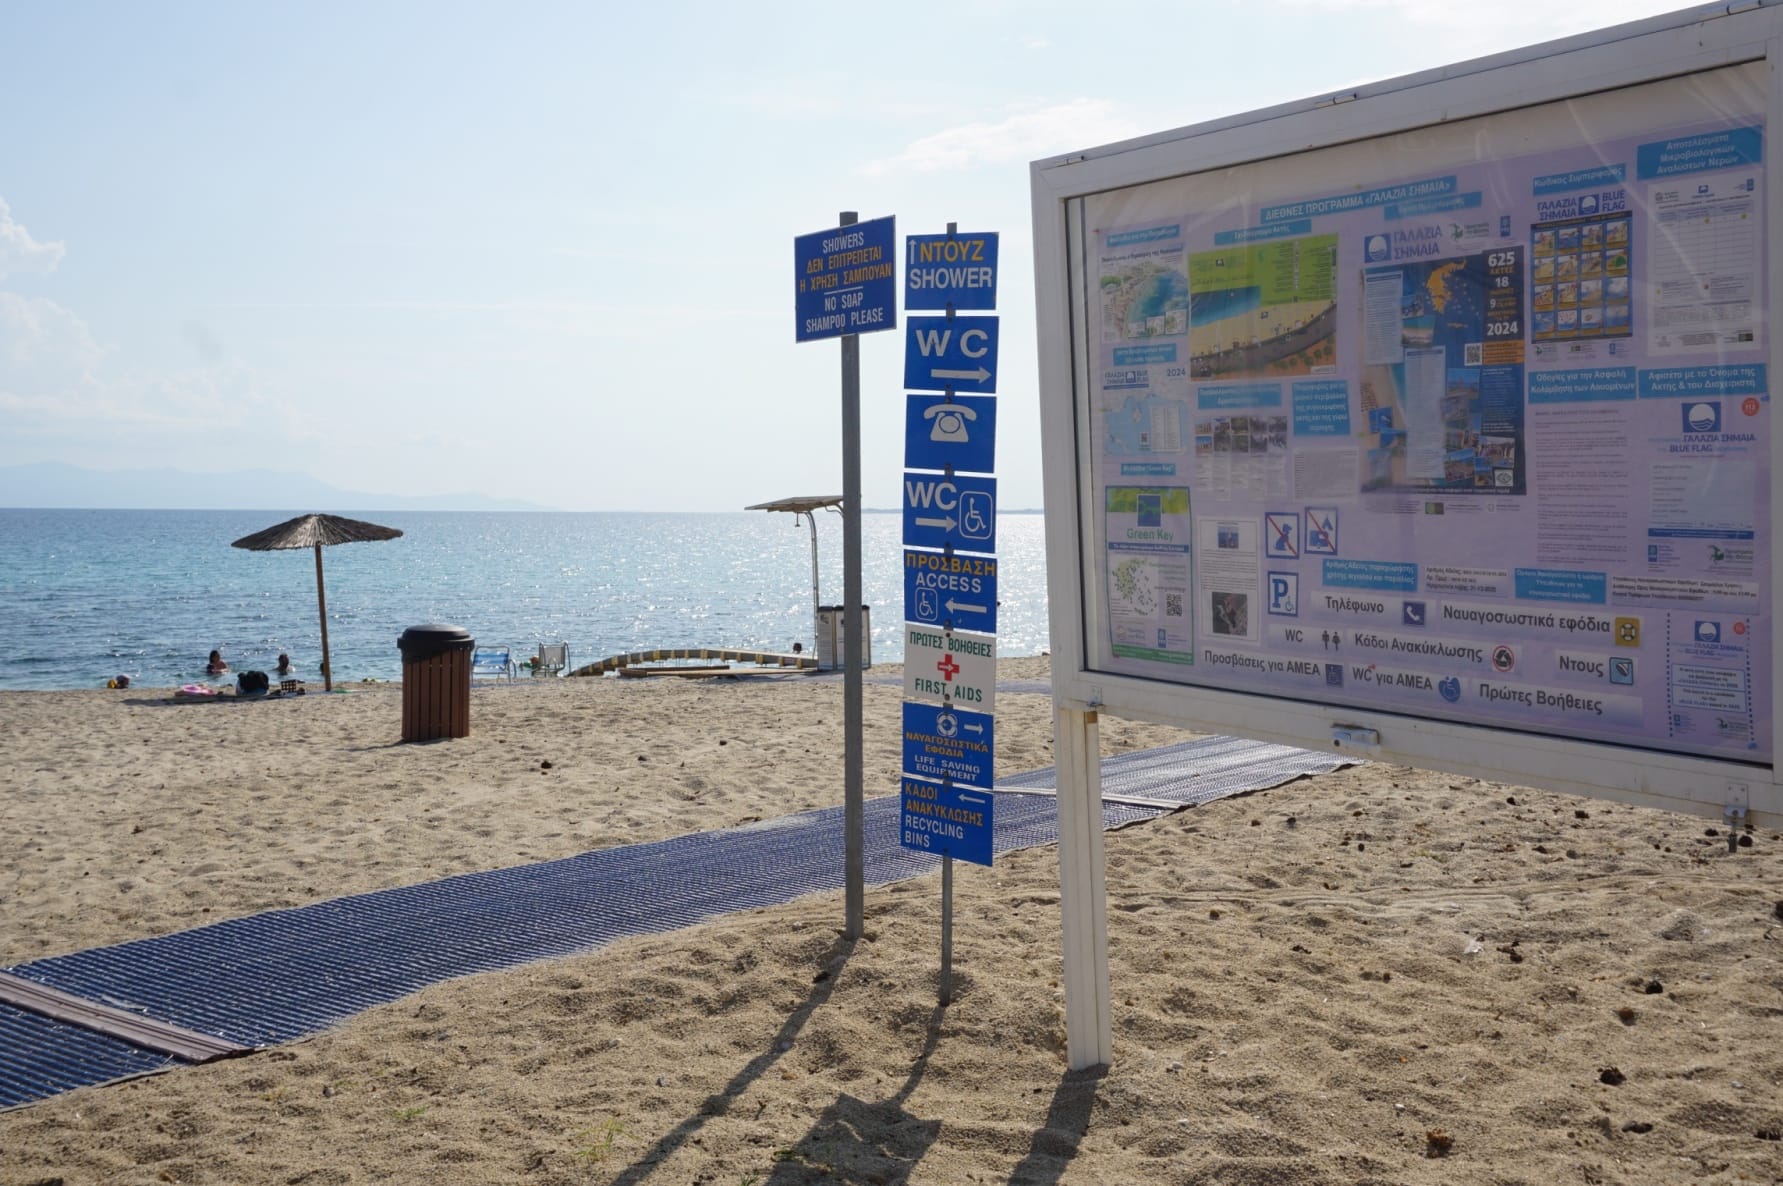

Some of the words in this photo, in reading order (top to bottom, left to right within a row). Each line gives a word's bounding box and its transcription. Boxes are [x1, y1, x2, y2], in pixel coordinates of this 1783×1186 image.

[1537, 197, 1577, 211] ΓΑΛΑΖΙΑ
[1602, 189, 1626, 202] BLUE
[1602, 200, 1626, 212] FLAG
[1265, 205, 1304, 220] ΔΙΕΘΝΕΣ
[1306, 197, 1364, 214] ΠΡΟΓΡΑΜΜΑ
[1539, 208, 1577, 221] ΣΗΜΑΙΑ
[822, 232, 864, 254] SHOWERS
[1393, 224, 1442, 244] ΓΑΛΑΖΙΑ
[806, 259, 824, 274] ΔΕΝ
[829, 246, 882, 270] ΕΠΙΤΡΕΠΕΤΑΙ
[920, 240, 984, 263] ΝΤΟΥΖ
[1394, 242, 1440, 259] ΣΗΜΑΙΑ
[1488, 252, 1515, 268] 625
[800, 278, 806, 293] Η
[811, 273, 838, 291] ΧΡΗΣΗ
[843, 262, 892, 285] ΣΑΜΠΟΥΑΝ
[910, 267, 992, 290] SHOWER
[1496, 276, 1509, 288] 18
[824, 295, 837, 311] NO
[841, 292, 864, 309] SOAP
[1490, 299, 1496, 309] 9
[806, 314, 846, 333] SHAMPOO
[851, 307, 884, 326] PLEASE
[1487, 322, 1518, 336] 2024
[906, 481, 957, 510] WC
[1127, 528, 1157, 540] Green
[1158, 530, 1174, 542] Key
[906, 553, 995, 576] ΠΡΟΣΒΑΣΗ
[916, 572, 982, 593] ACCESS
[1272, 578, 1288, 608] P
[1325, 596, 1385, 614] Τηλέφωνο
[1444, 606, 1554, 628] Ναυαγοσωστικά
[1560, 616, 1610, 633] εφόδια
[910, 632, 944, 649] ΠΡΩΤΕΣ
[948, 638, 992, 658] ΒΟΗΘΕΙΕΣ
[1285, 629, 1304, 642] WC
[1354, 634, 1388, 650] Κάδοι
[1392, 637, 1483, 662] Ανακύκλωσης
[1204, 650, 1265, 672] Προσβάσεις
[1268, 660, 1284, 672] για
[1286, 660, 1320, 676] ΑΜΕΑ
[1560, 656, 1604, 677] Ντους
[1352, 667, 1372, 682] WC
[1376, 672, 1393, 686] για
[1396, 673, 1433, 690] ΑΜΕΑ
[915, 678, 947, 696] FIRST
[954, 686, 982, 702] AIDS
[1480, 684, 1532, 706] Πρώτες
[1536, 690, 1602, 714] Βοήθειες
[925, 745, 964, 758] ΕΦΟΔΙΑ
[914, 755, 935, 766] LIFE
[942, 760, 980, 774] SAVING
[916, 764, 977, 781] EQUIPMENT
[905, 783, 938, 800] ΚΑΔΟΙ
[906, 800, 983, 827] ΑΝΑΚΥΚΛΩΣΗΣ
[905, 814, 964, 839] RECYCLING
[905, 831, 930, 848] BINS
